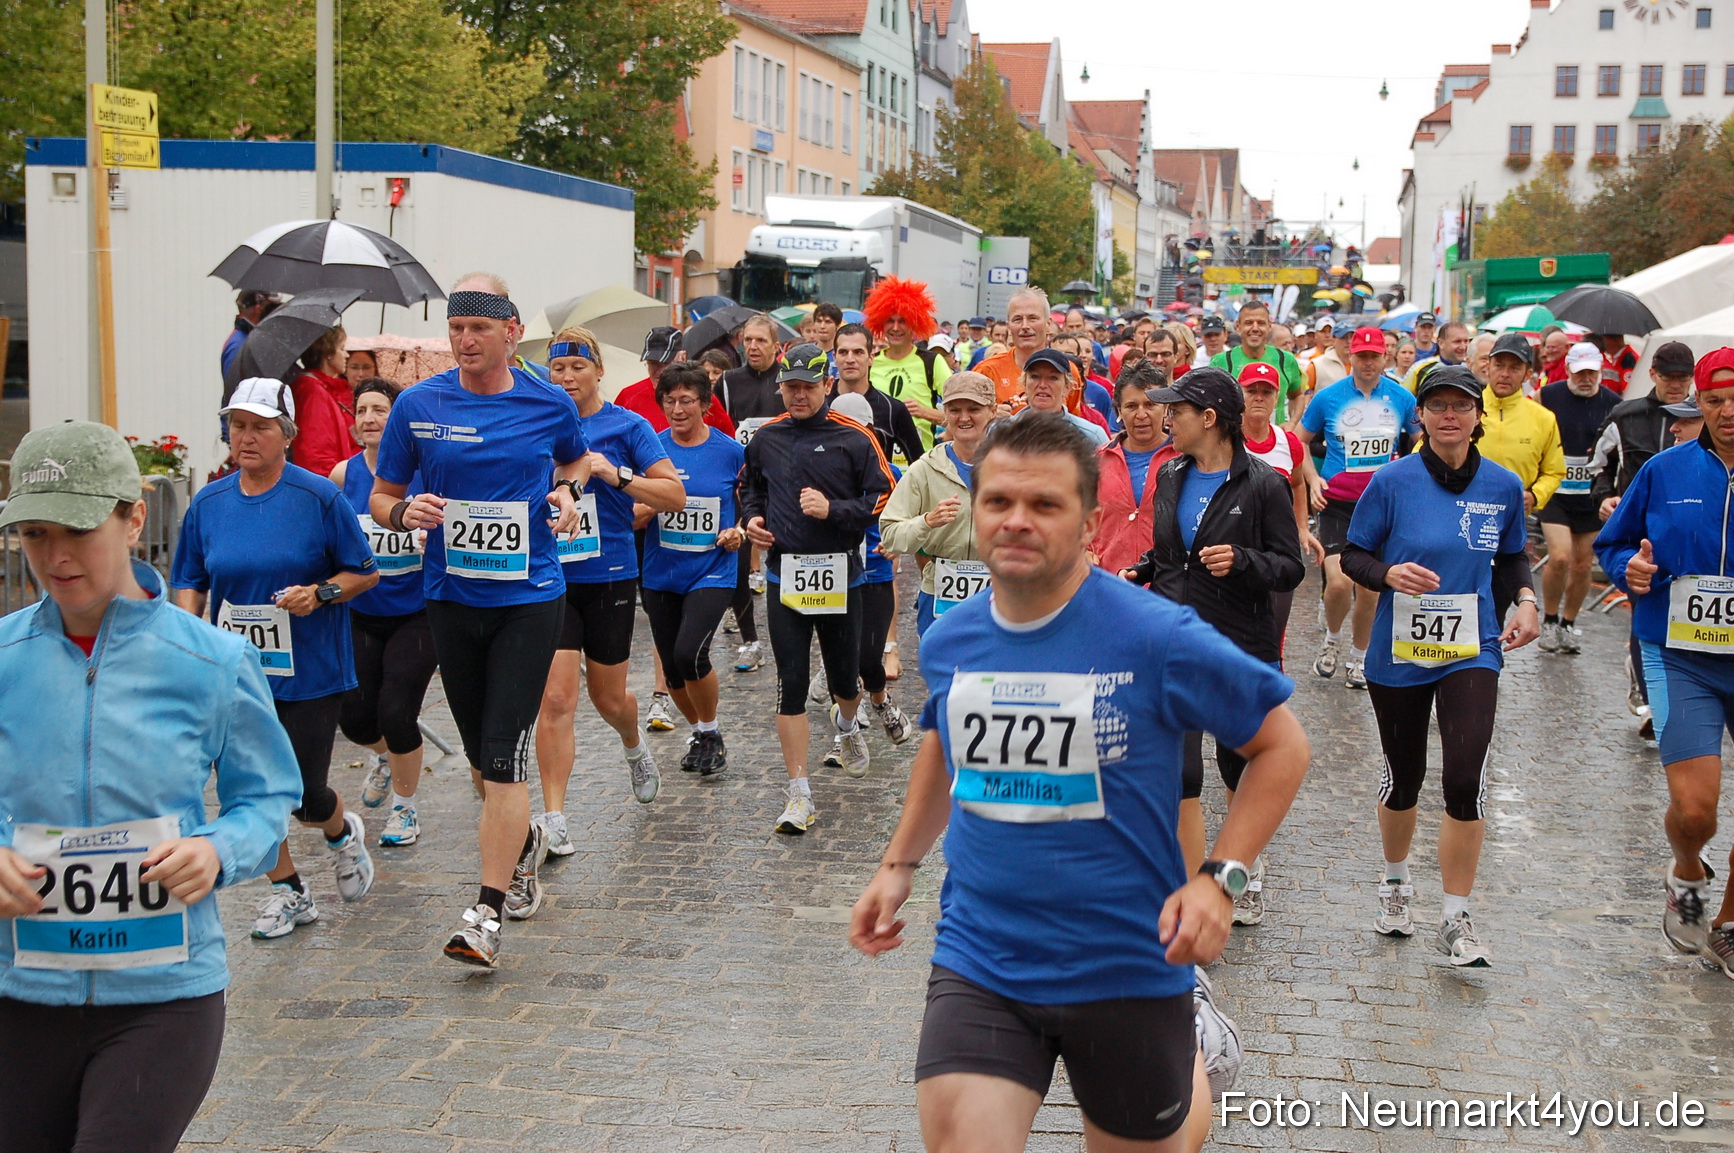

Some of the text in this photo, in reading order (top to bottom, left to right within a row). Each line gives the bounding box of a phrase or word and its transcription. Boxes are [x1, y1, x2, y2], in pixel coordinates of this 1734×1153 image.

[777, 237, 839, 250] BOCK
[1240, 271, 1279, 281] START
[1350, 438, 1390, 456] 2790
[22, 468, 60, 484] PUMA
[468, 505, 504, 515] BOCK
[664, 511, 713, 532] 2918
[452, 520, 521, 551] 2429
[462, 556, 508, 569] Manfred
[795, 569, 834, 592] 546
[942, 575, 992, 600] 297
[801, 596, 826, 606] Alfred
[1420, 599, 1454, 608] BOCK
[231, 609, 263, 618] BOCK
[1687, 594, 1734, 626] 649
[1411, 613, 1462, 642] 547
[1694, 628, 1730, 643] Achim
[1412, 645, 1459, 659] Katarina
[992, 683, 1046, 699] BOCK
[963, 712, 1077, 768] 2727
[983, 776, 1063, 801] Matthias
[69, 927, 128, 949] Karin
